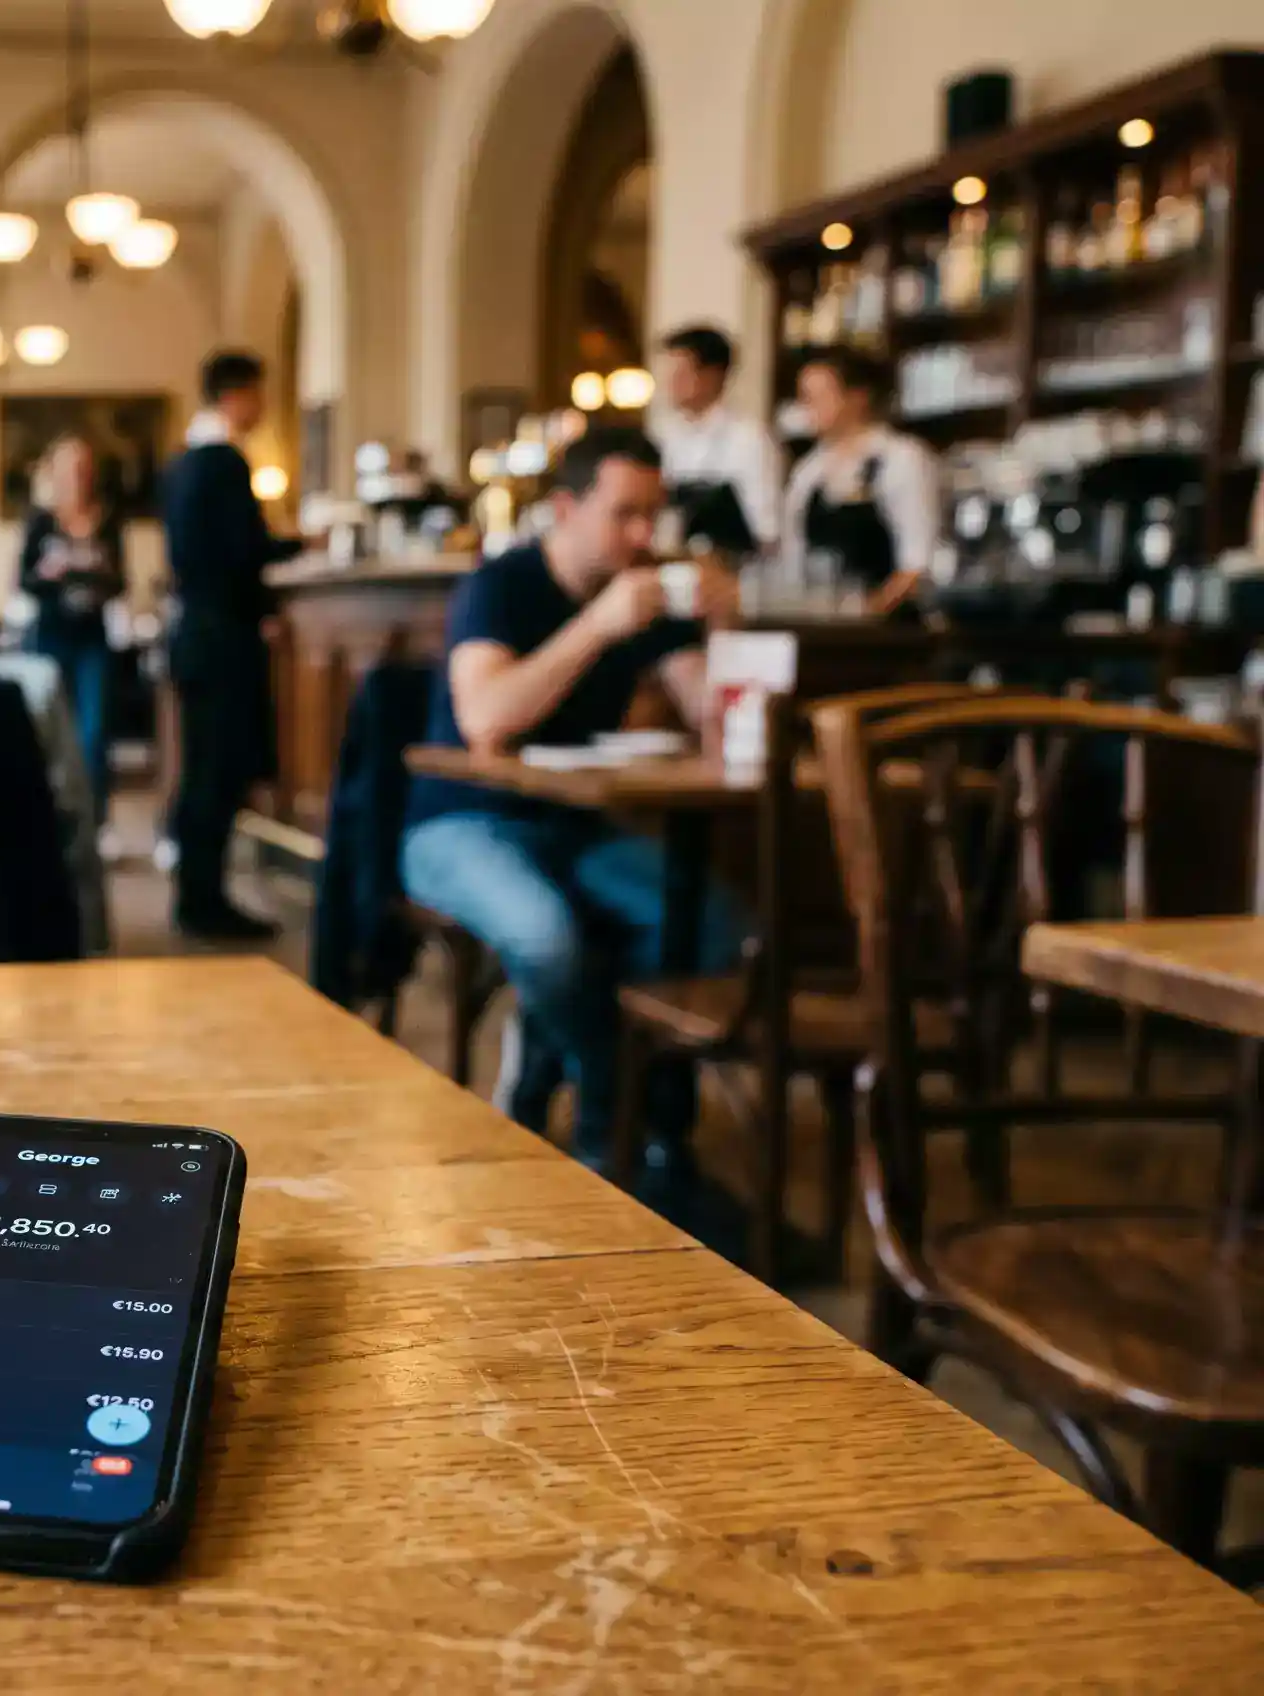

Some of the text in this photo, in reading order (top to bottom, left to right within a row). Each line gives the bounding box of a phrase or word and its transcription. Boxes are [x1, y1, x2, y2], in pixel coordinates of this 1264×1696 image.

[17, 1150, 100, 1167] George
[112, 1300, 173, 1314] €15.00
[99, 1345, 164, 1361] €15.90
